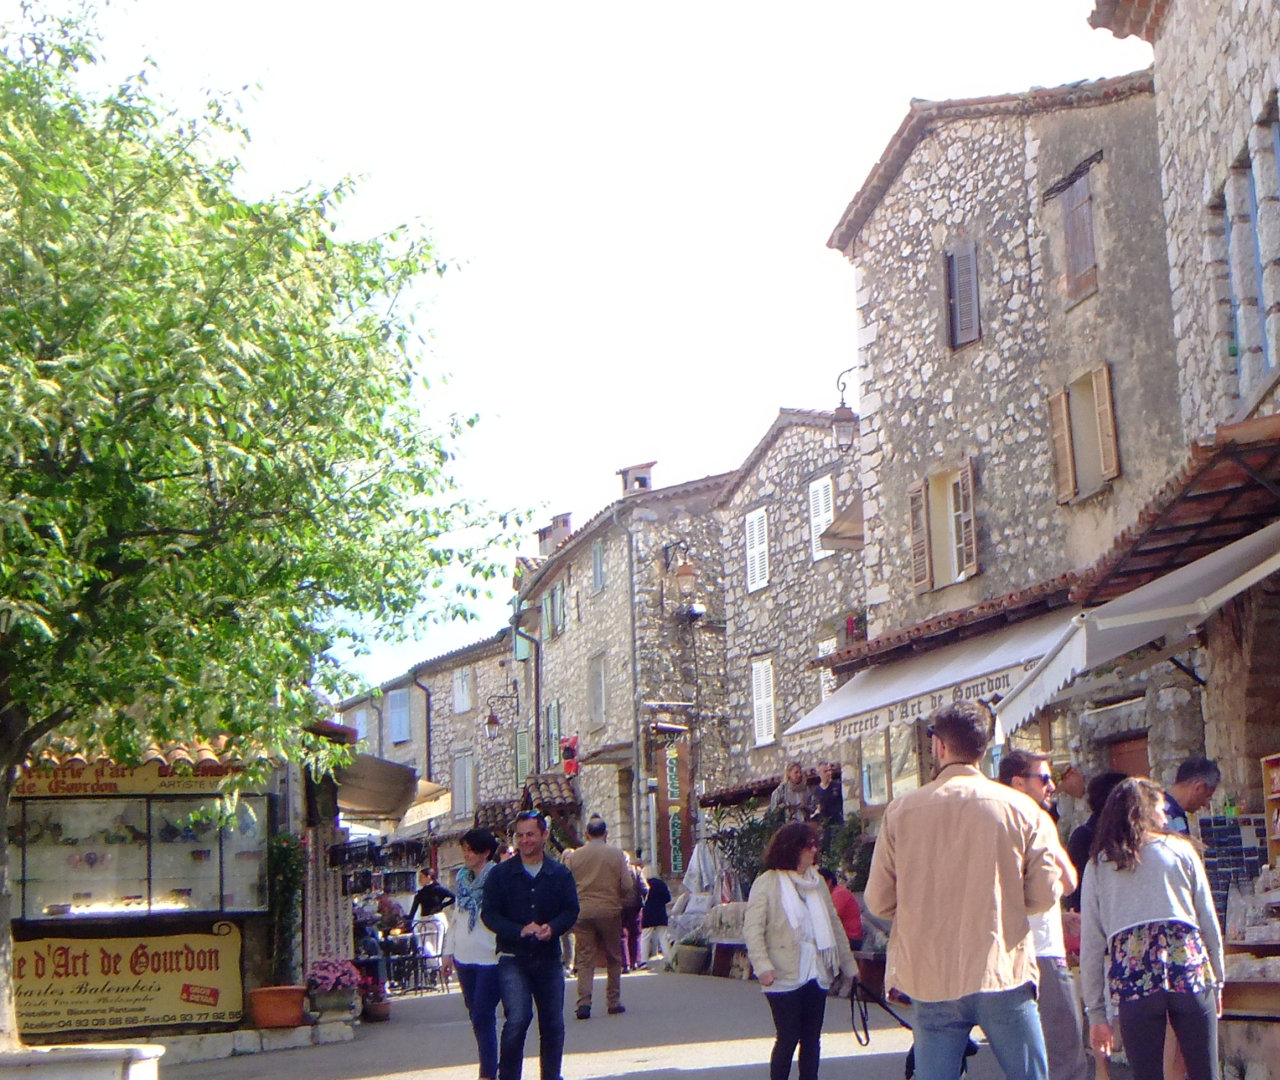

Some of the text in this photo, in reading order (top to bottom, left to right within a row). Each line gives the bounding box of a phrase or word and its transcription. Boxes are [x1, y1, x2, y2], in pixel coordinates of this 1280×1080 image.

[833, 713, 880, 739] Verrerie
[888, 700, 923, 722] d'Art
[930, 694, 944, 708] de
[952, 674, 1011, 702] Gourdon
[666, 750, 680, 800] SOURCE
[34, 943, 89, 979] d'Art
[100, 947, 122, 976] de
[130, 943, 220, 976] Gourdon
[14, 982, 64, 998] harles
[75, 1018, 89, 1027] 93
[180, 1013, 193, 1022] 93
[196, 1012, 209, 1021] 77
